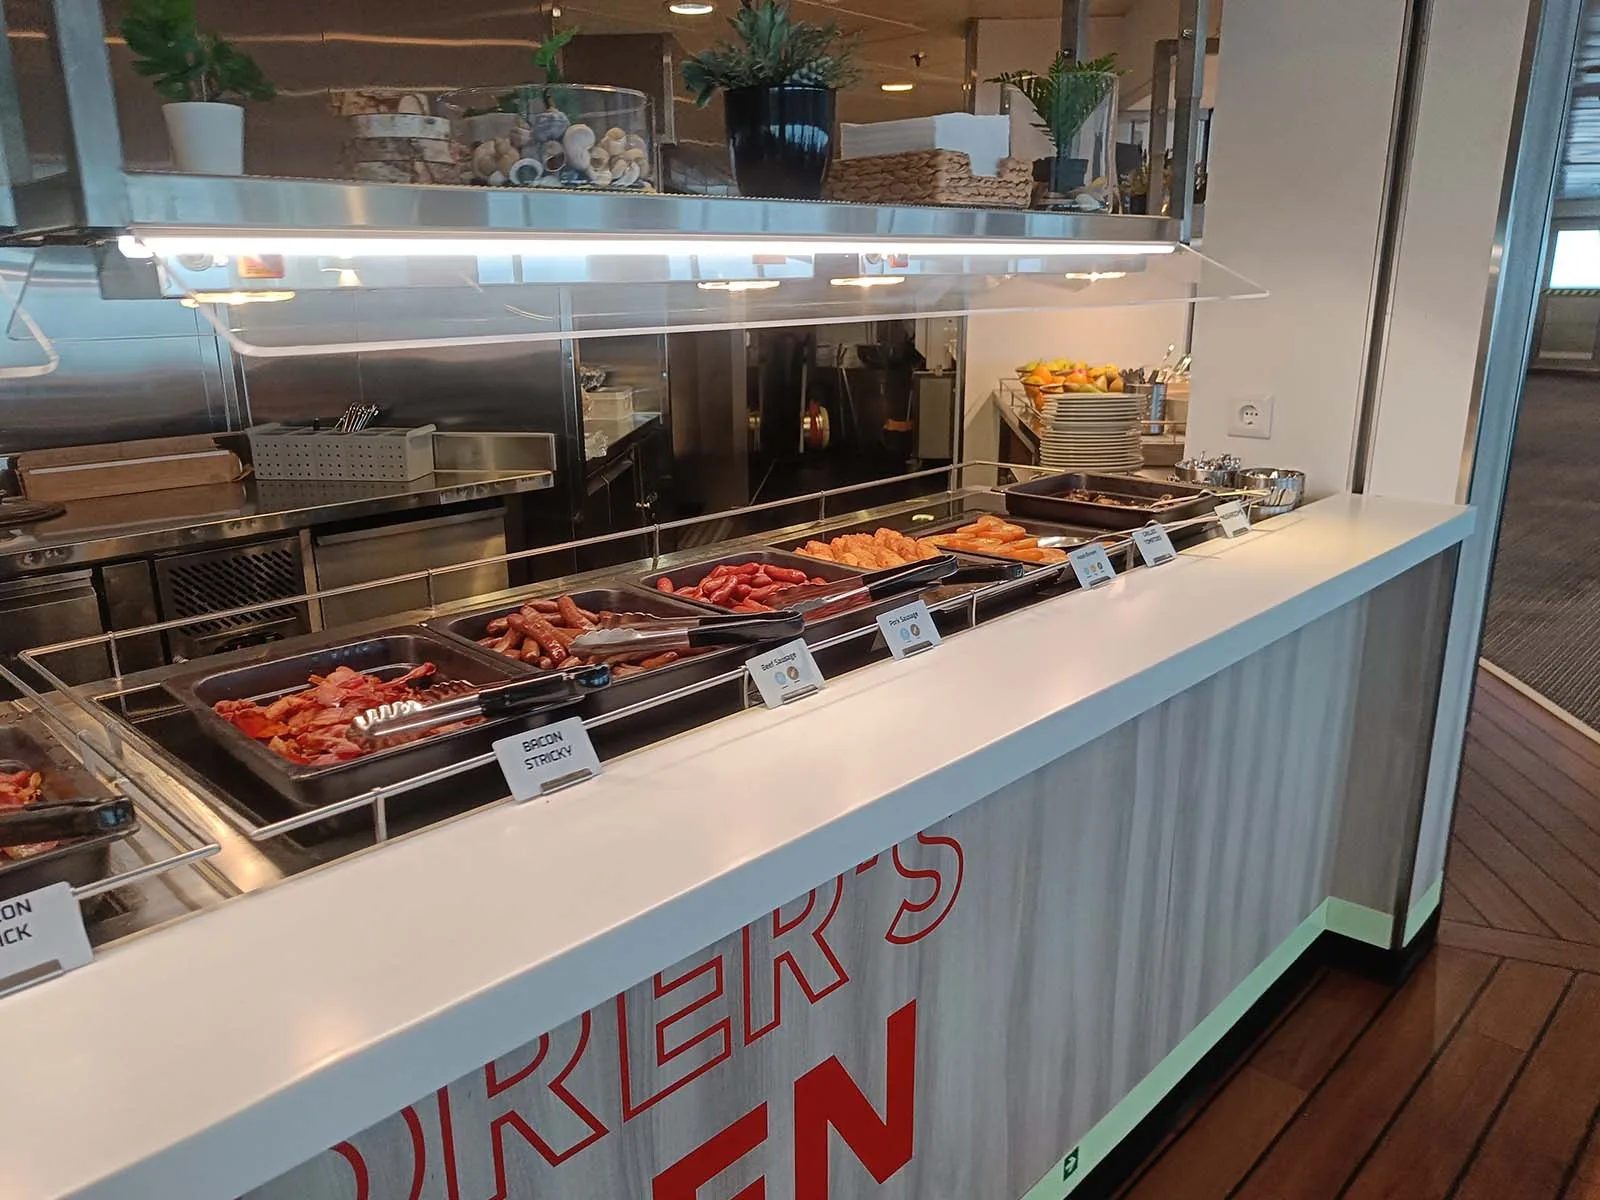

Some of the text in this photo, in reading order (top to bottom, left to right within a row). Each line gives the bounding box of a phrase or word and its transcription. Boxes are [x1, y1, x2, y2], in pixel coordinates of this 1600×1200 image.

[760, 652, 797, 672] Beef Sausage
[522, 731, 564, 753] BACON
[523, 745, 572, 770] STRICKY
[0, 898, 32, 923] ON
[330, 831, 964, 1200] RERS
